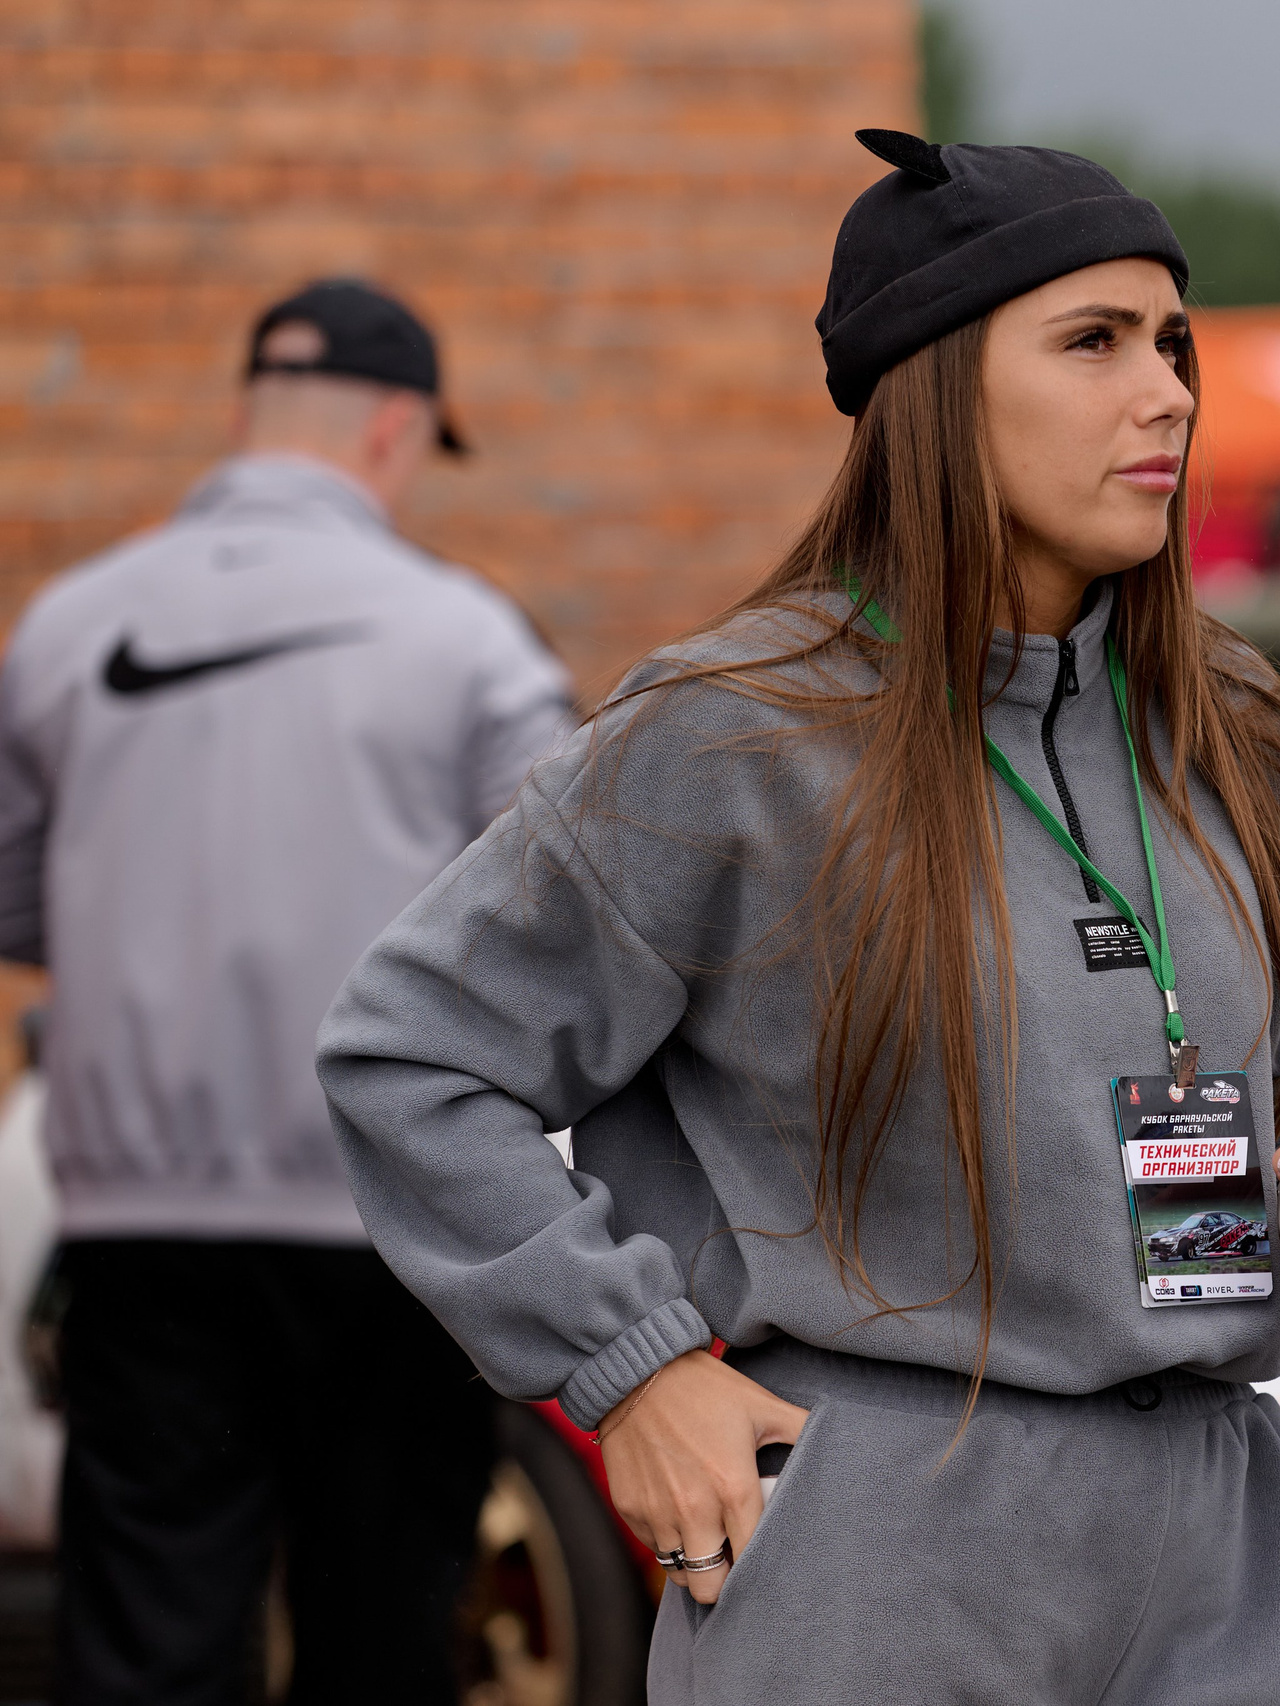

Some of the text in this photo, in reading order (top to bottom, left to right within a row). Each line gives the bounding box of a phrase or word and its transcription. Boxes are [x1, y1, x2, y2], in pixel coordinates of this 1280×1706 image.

[1085, 924, 1130, 936] NEWSTYLE
[1202, 1088, 1240, 1099] РАКЕТА
[1141, 1111, 1233, 1124] КУБОК БАРНАУЛЬСКОЙ
[1172, 1124, 1205, 1134] РАКЕТЫ
[1140, 1140, 1237, 1159] ТЕХНИЧЕСКИЙ
[1142, 1160, 1240, 1176] ОРГАНИЗАТОР
[1206, 1286, 1234, 1294] RIVER
